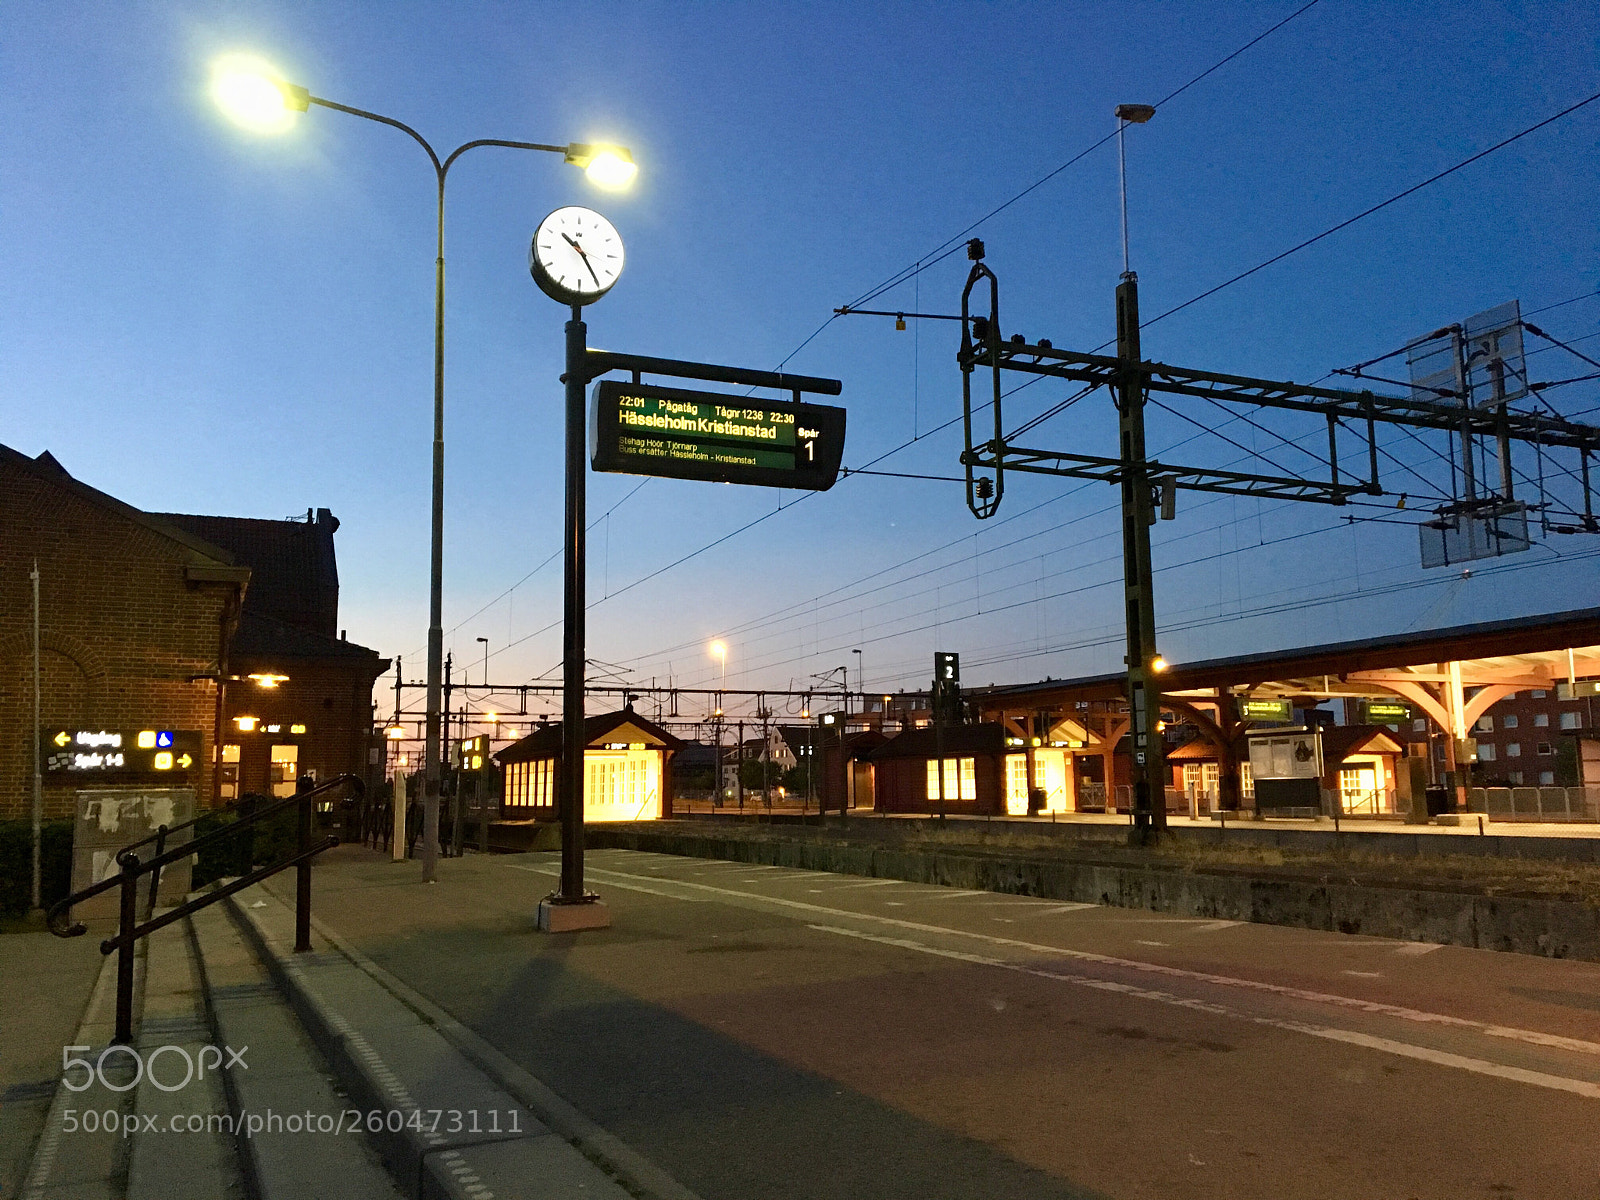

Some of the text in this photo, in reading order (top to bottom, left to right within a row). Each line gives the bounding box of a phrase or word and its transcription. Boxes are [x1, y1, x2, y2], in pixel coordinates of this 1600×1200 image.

[619, 395, 795, 424] 22:01 Pågatåg Tågnr 1236 22:30
[618, 409, 777, 440] Hässleholm Kristianstad
[798, 427, 820, 439] Spår
[804, 440, 814, 461] 1
[946, 666, 954, 679] 2
[75, 752, 103, 769] Spår
